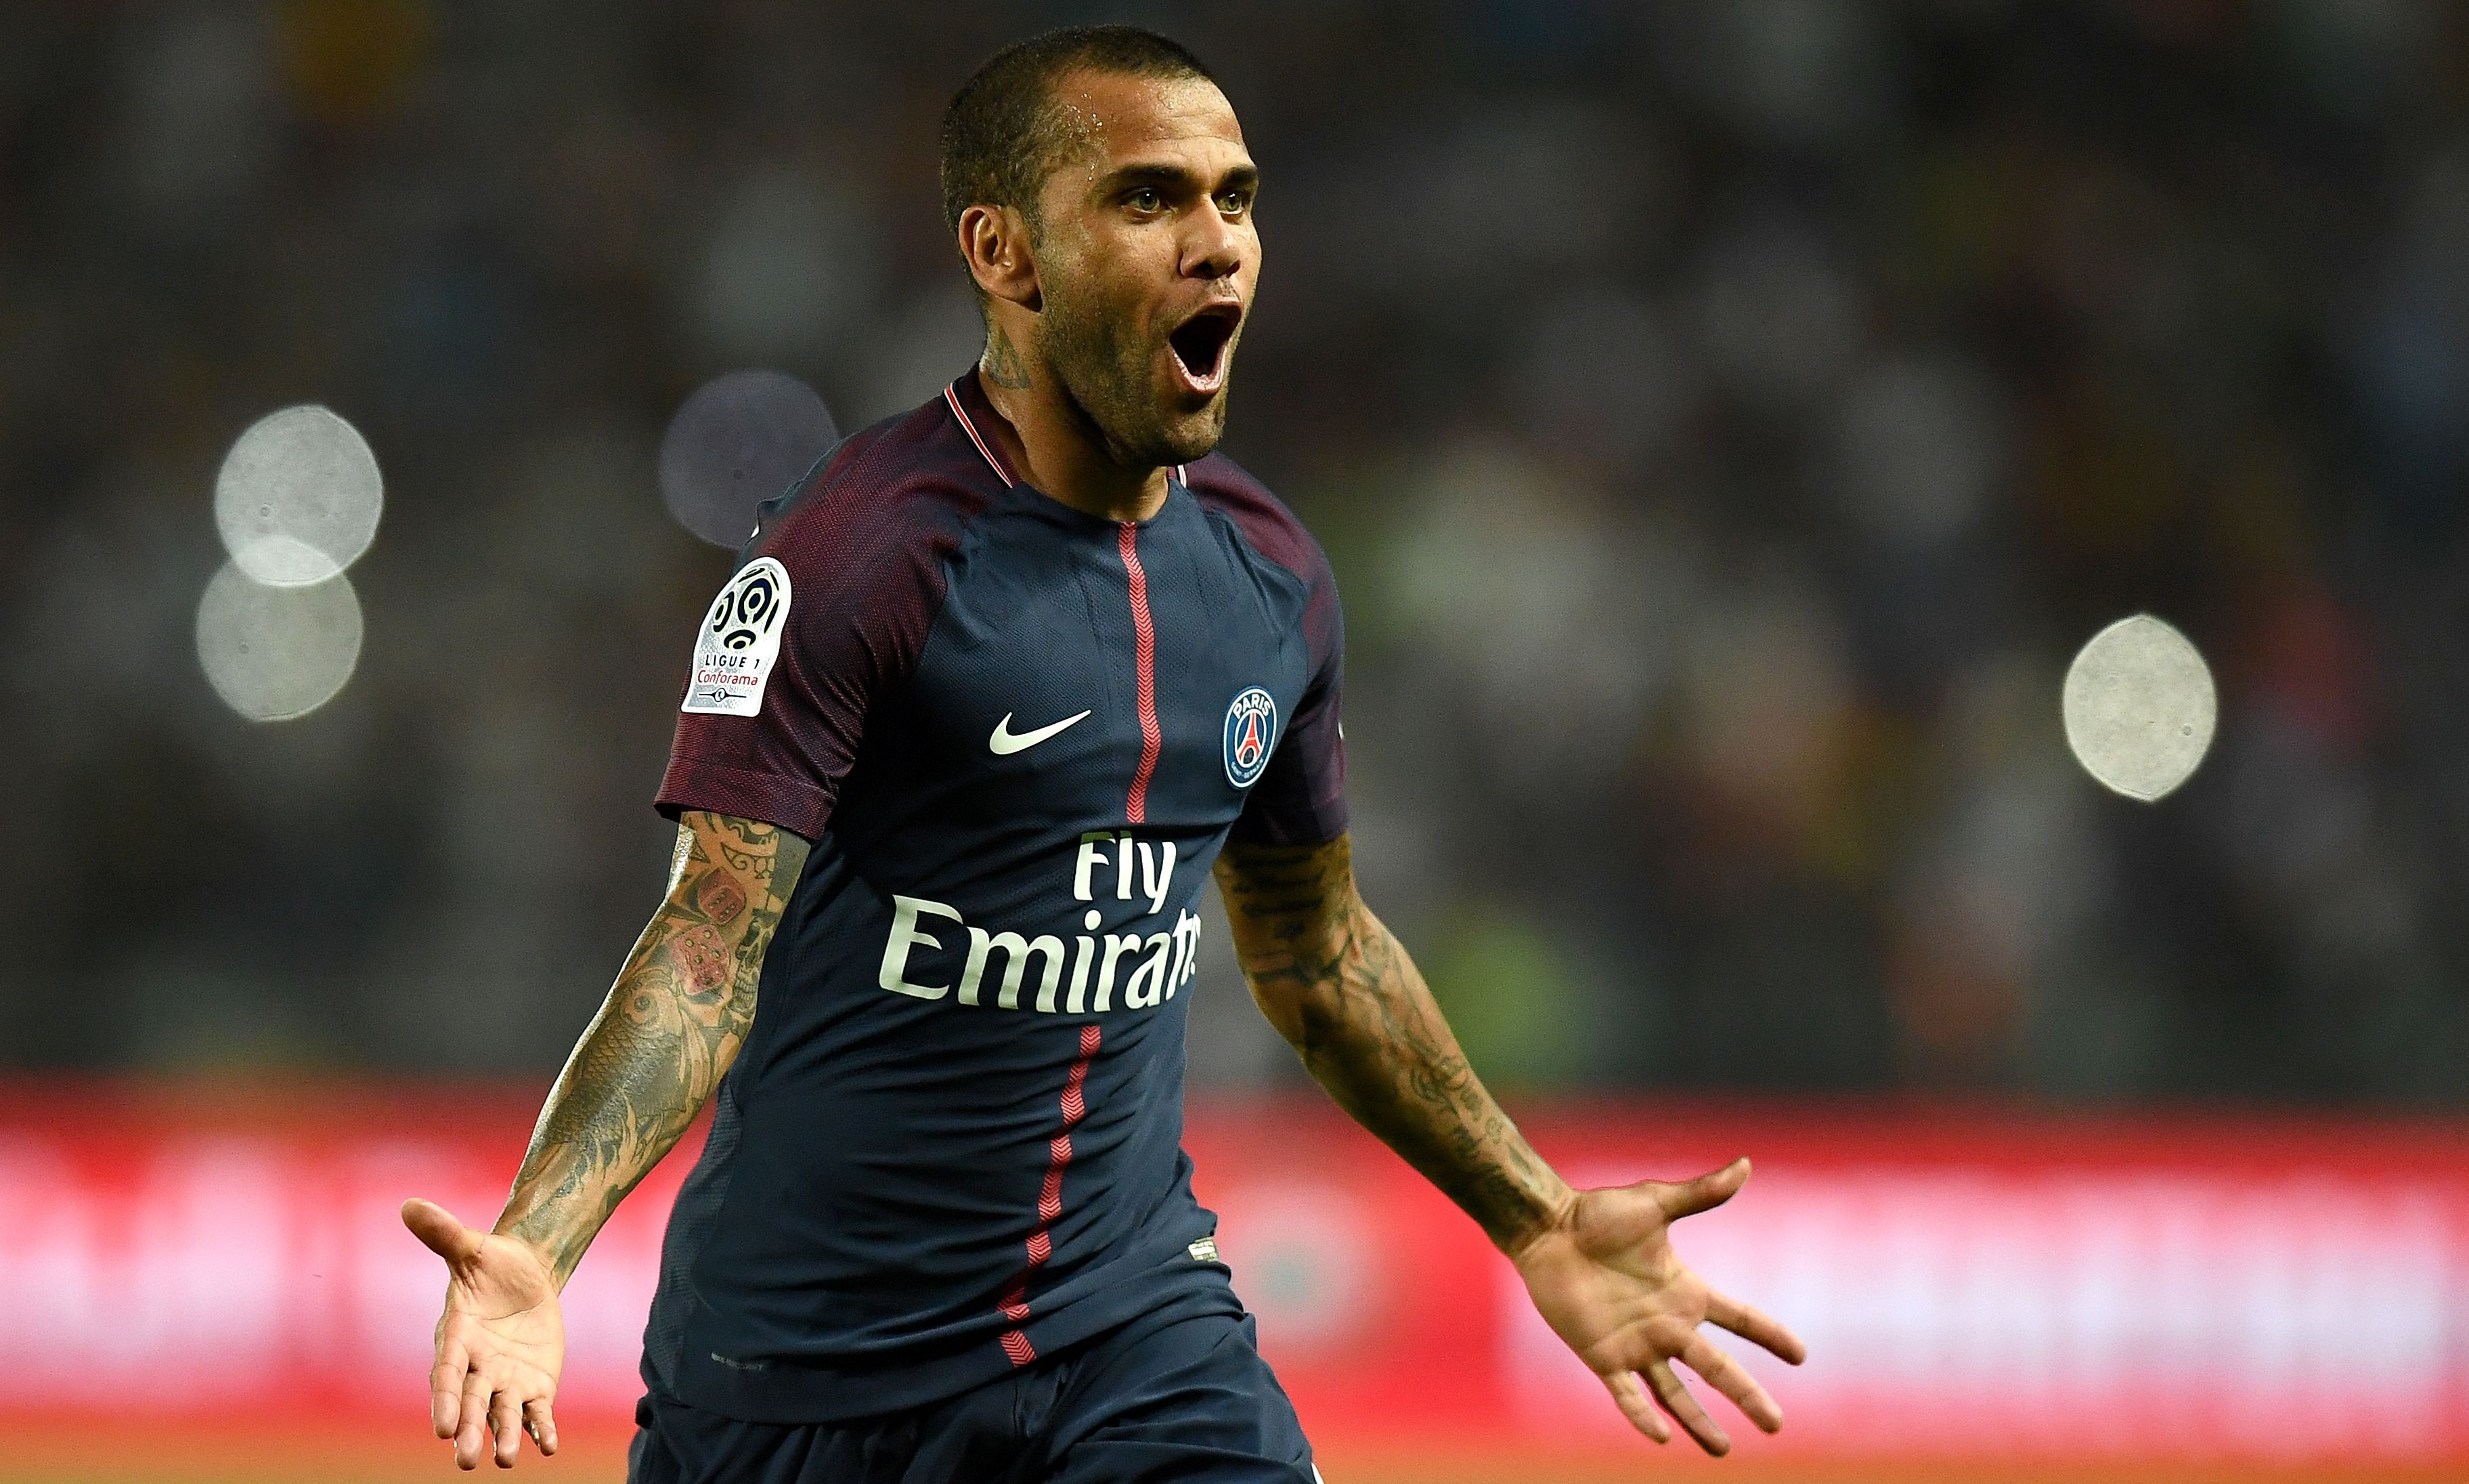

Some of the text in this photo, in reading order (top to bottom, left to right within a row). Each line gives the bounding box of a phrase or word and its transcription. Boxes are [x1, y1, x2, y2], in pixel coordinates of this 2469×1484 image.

[705, 655, 760, 669] LIGUE 1
[697, 670, 758, 686] Conforama
[1232, 694, 1271, 719] PARIS
[1074, 830, 1177, 914] Fly
[879, 894, 1201, 1014] Emirat
